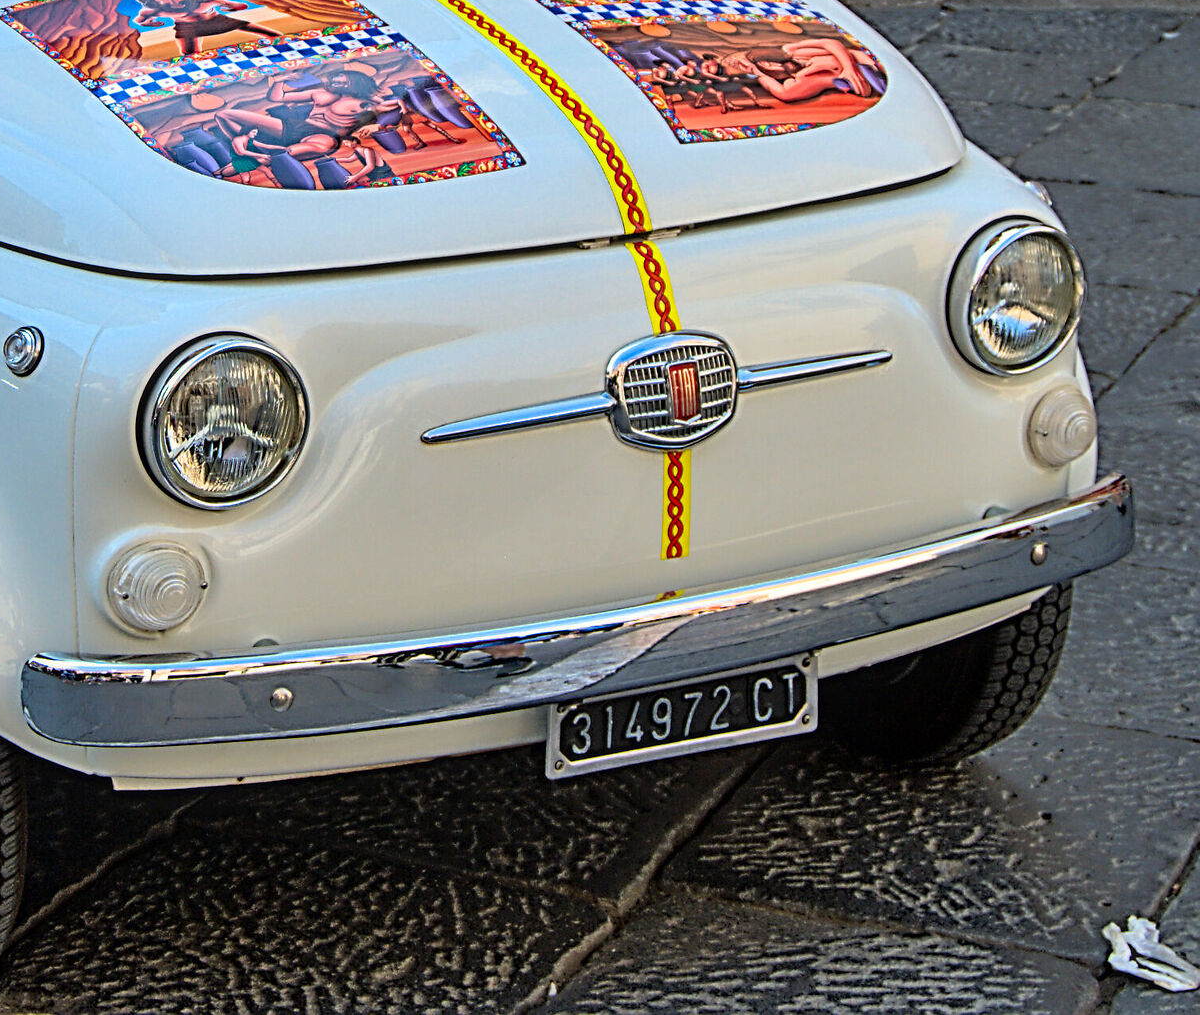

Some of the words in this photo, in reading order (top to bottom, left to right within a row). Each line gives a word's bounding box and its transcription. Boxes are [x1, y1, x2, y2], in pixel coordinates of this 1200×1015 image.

[672, 367, 697, 418] FIAT
[571, 685, 732, 755] 314972
[753, 672, 799, 723] CT
